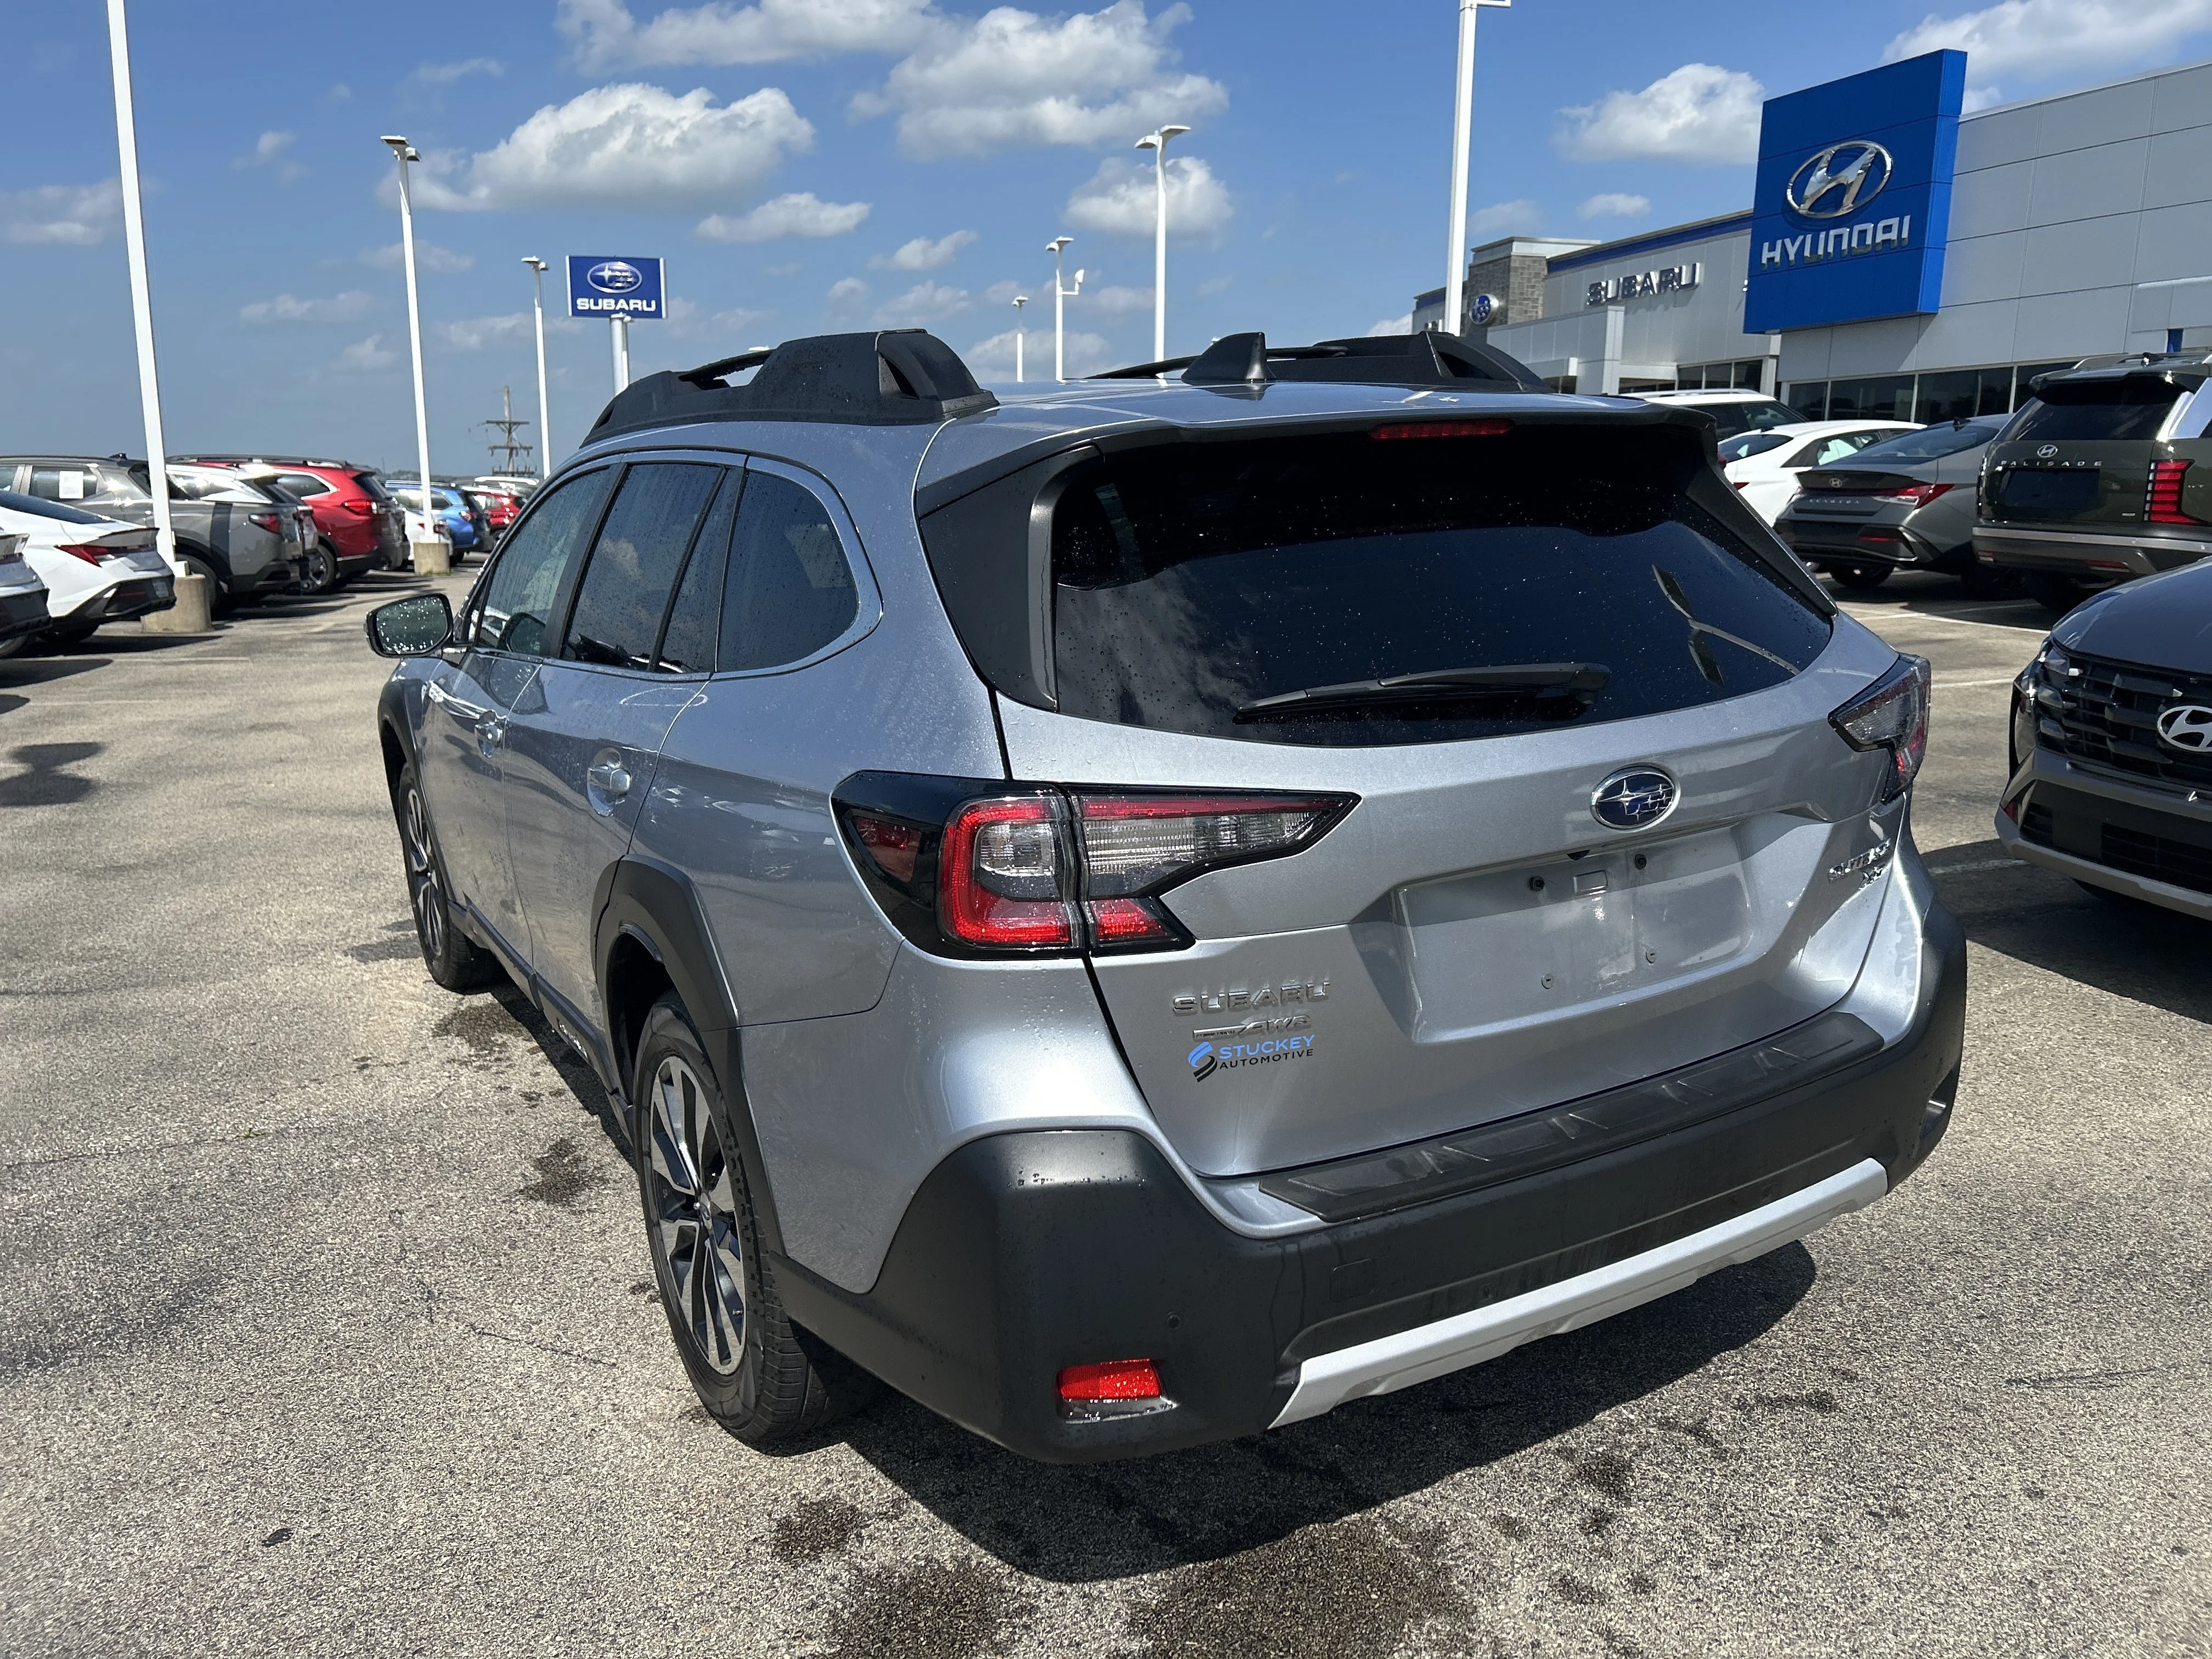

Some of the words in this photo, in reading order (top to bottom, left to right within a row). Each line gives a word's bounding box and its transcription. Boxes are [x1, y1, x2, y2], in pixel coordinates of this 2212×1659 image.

[1761, 215, 1911, 269] HYUNDAI
[1587, 262, 1700, 306] SUBARU
[577, 298, 656, 312] SUBARU
[1172, 981, 1330, 1014] SUBARU
[1219, 1049, 1314, 1070] AUTOMOTIVE
[1220, 1035, 1315, 1059] STUCKEY
